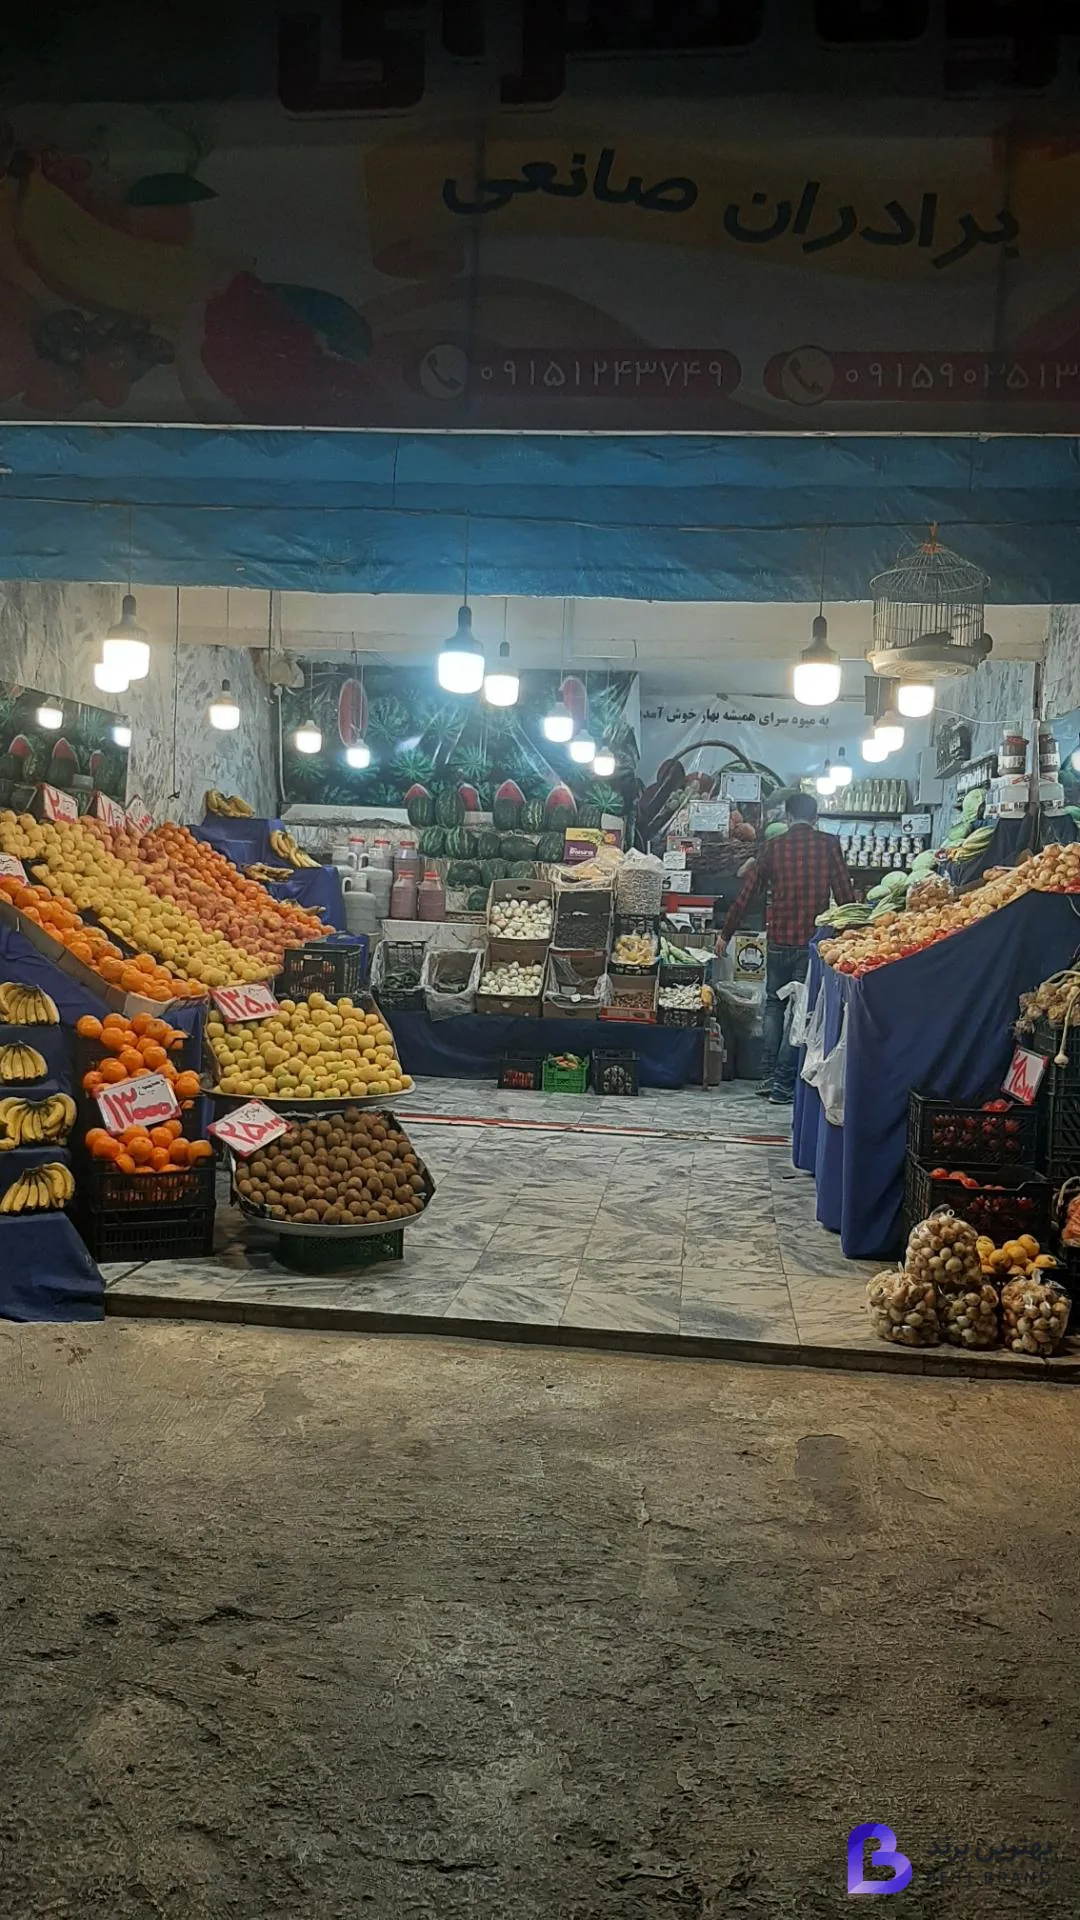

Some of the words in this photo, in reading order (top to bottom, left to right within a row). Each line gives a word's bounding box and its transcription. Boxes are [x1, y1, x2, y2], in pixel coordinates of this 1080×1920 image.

[442, 148, 698, 215] صانعی
[723, 181, 1020, 269] برادران
[480, 359, 724, 388] ۰۹۱۵۱۲۴۳۷۴۹
[639, 706, 664, 719] آمد
[666, 708, 697, 724] خوش
[701, 708, 720, 724] بهار
[723, 709, 756, 725] همیشه
[758, 711, 789, 727] سرای
[791, 716, 816, 729] میوه
